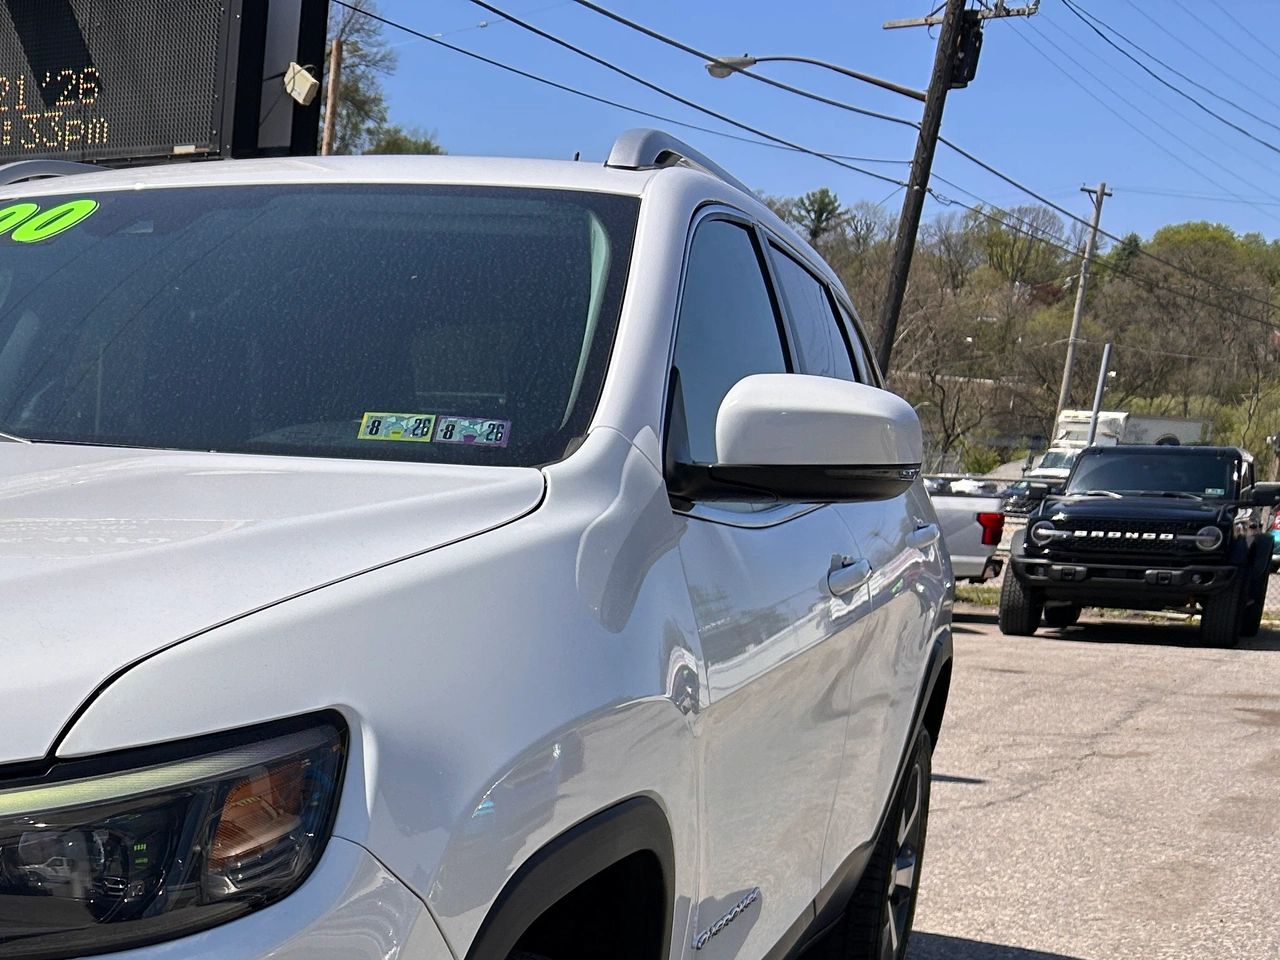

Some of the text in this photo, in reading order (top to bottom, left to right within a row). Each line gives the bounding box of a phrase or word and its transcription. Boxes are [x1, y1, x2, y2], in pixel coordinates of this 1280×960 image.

[42, 67, 100, 105] '26
[368, 419, 382, 436] 8
[442, 422, 505, 442] 8 26
[1073, 530, 1174, 540] BRONCO
